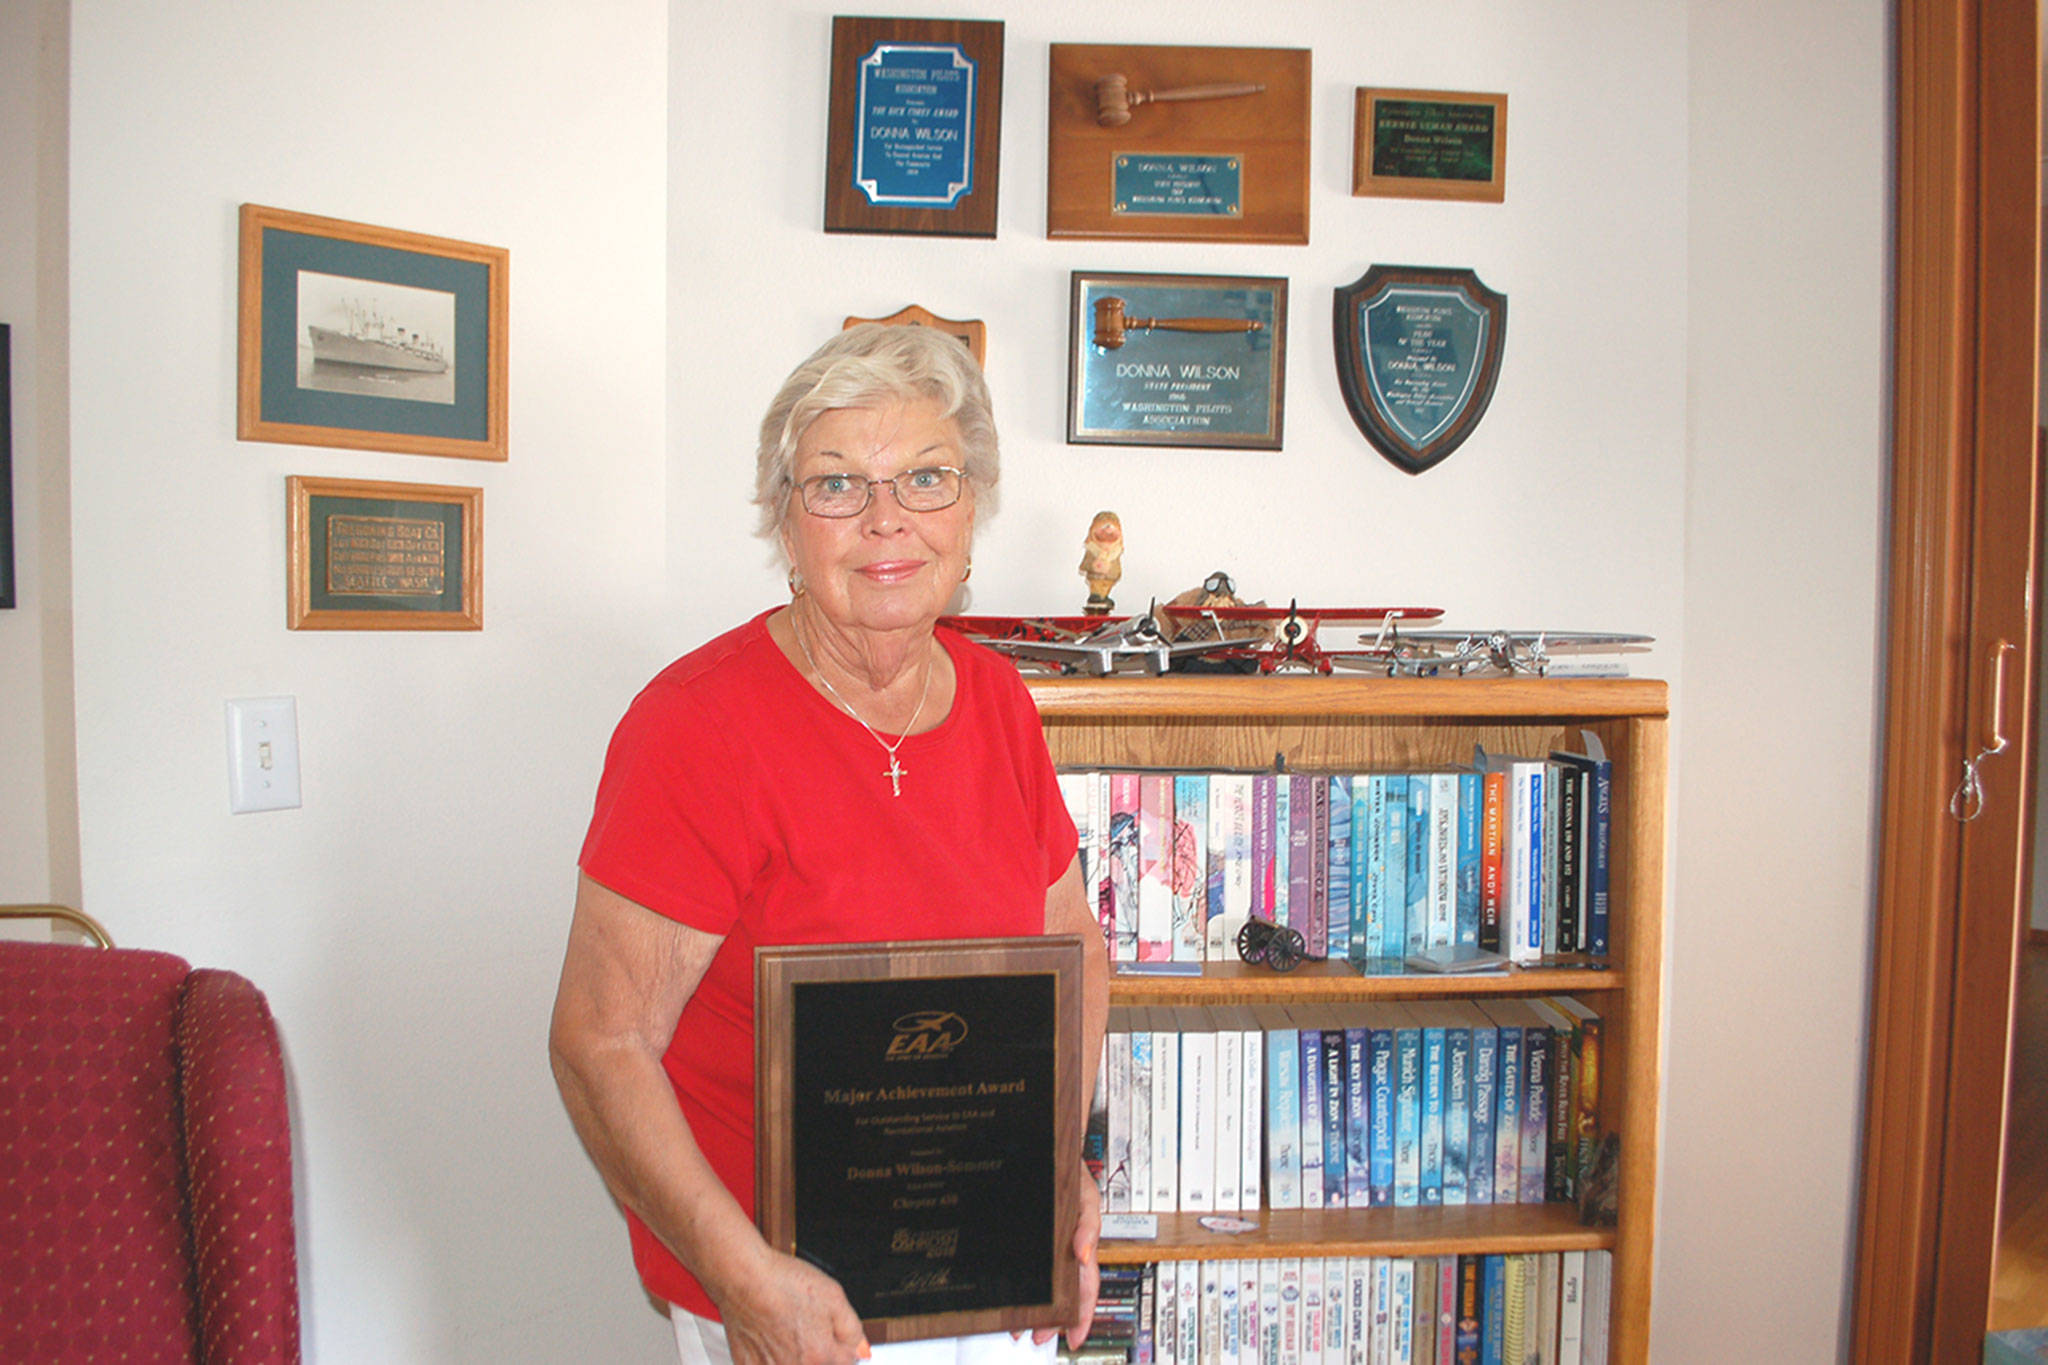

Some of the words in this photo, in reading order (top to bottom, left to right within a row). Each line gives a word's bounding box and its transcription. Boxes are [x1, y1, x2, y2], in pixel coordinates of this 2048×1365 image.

[870, 126, 909, 140] DONNA
[915, 128, 959, 142] WILSON
[1116, 363, 1171, 378] DONNA
[1179, 365, 1240, 380] WILSON
[1122, 403, 1190, 413] WASHINGTON
[1142, 415, 1211, 426] ASSOCIATION
[1488, 783, 1497, 803] THE
[1564, 778, 1574, 795] THE
[1598, 776, 1610, 814] ANGELS
[1564, 796, 1574, 828] CESSNA
[1488, 807, 1496, 856] MARTIAN
[1564, 845, 1573, 862] AND
[1486, 865, 1496, 894] ANDY
[1486, 898, 1495, 926] WEIR
[886, 1032, 953, 1055] EAA
[1328, 1049, 1338, 1057] A
[1350, 1043, 1360, 1061] THE
[1430, 1044, 1441, 1063] THE
[1506, 1044, 1518, 1064] THE
[1328, 1058, 1338, 1086] LIGHT
[1350, 1062, 1360, 1080] KEY
[1371, 1050, 1390, 1085] Prague
[1402, 1047, 1416, 1084] Munich
[1452, 1048, 1466, 1101] Jerusalem
[1476, 1048, 1493, 1082] Danzig
[1530, 1049, 1545, 1084] Vienna
[1306, 1055, 1316, 1102] DAUGHTER
[1350, 1082, 1361, 1094] TO
[1428, 1064, 1440, 1099] RETURN
[1504, 1065, 1516, 1097] GATES
[1558, 1074, 1570, 1098] RIVER
[824, 1088, 872, 1106] Major
[875, 1082, 973, 1102] Achievement
[976, 1078, 1026, 1096] Award
[1328, 1087, 1338, 1098] IN
[1528, 1085, 1544, 1122] Prelude
[1328, 1100, 1339, 1122] ZION
[1350, 1096, 1362, 1118] ZION
[1474, 1084, 1492, 1124] Passage
[1504, 1099, 1515, 1112] OF
[1372, 1086, 1390, 1150] Counterpoint
[847, 1164, 892, 1181] Donna
